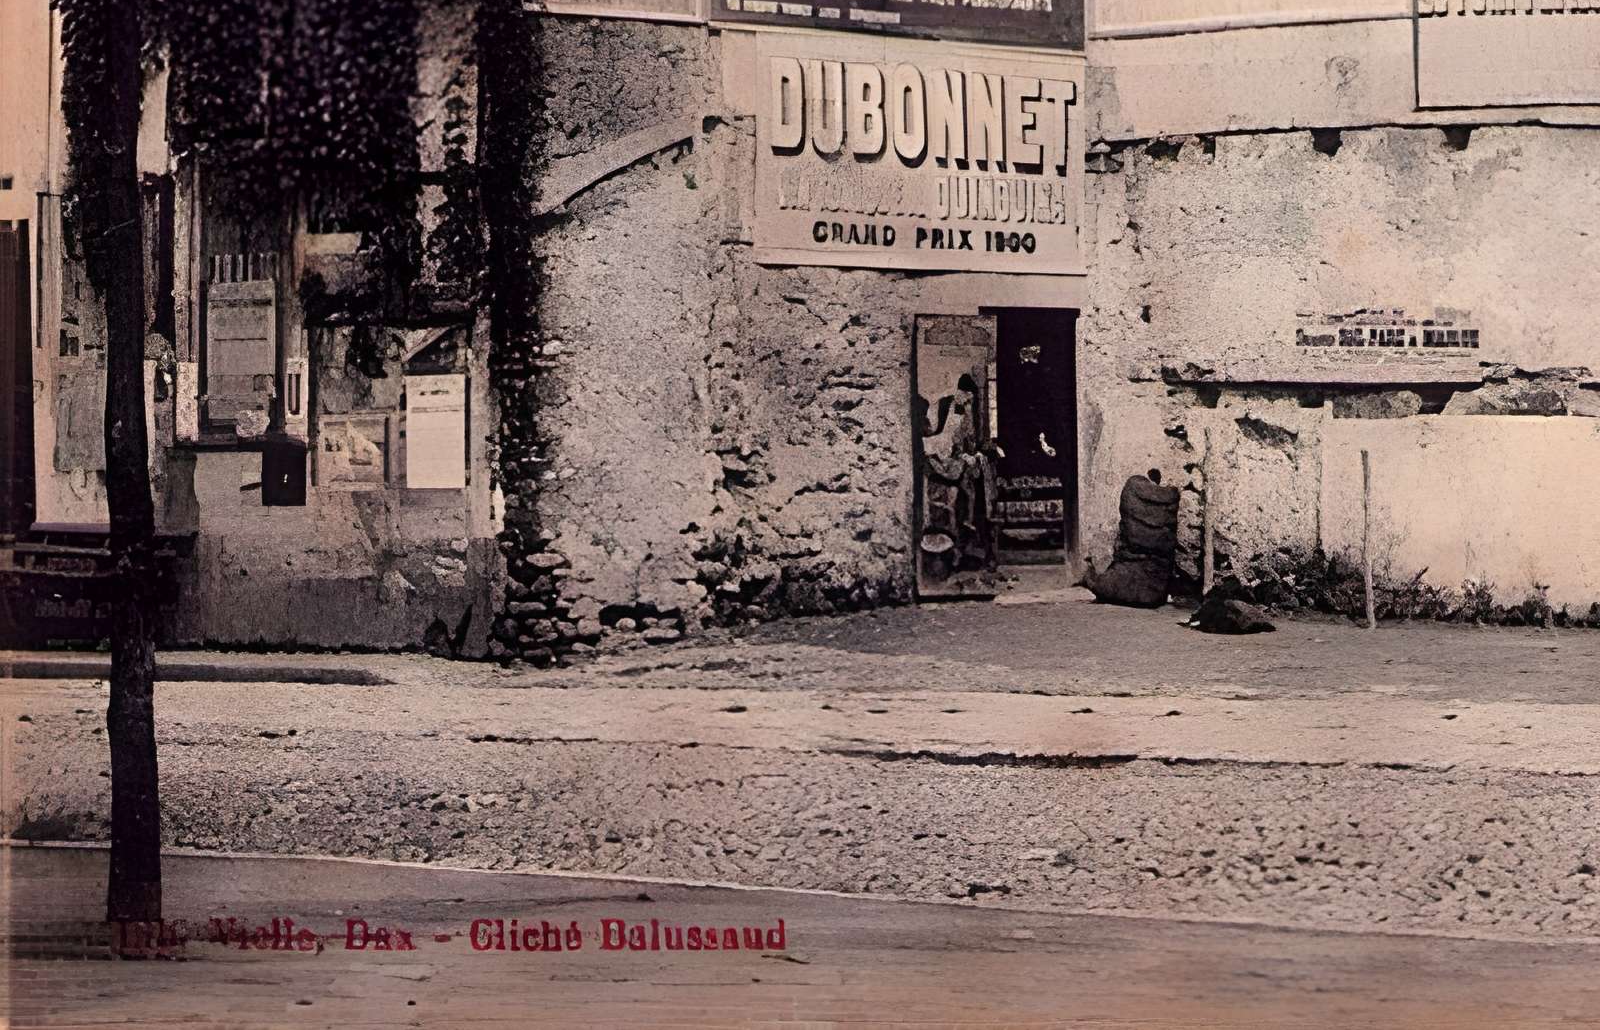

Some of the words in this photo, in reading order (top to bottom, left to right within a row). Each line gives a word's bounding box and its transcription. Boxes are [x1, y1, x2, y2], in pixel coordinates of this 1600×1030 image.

[770, 56, 1078, 177] DUBONNET
[812, 220, 897, 247] GRAND
[915, 226, 975, 251] PRIX
